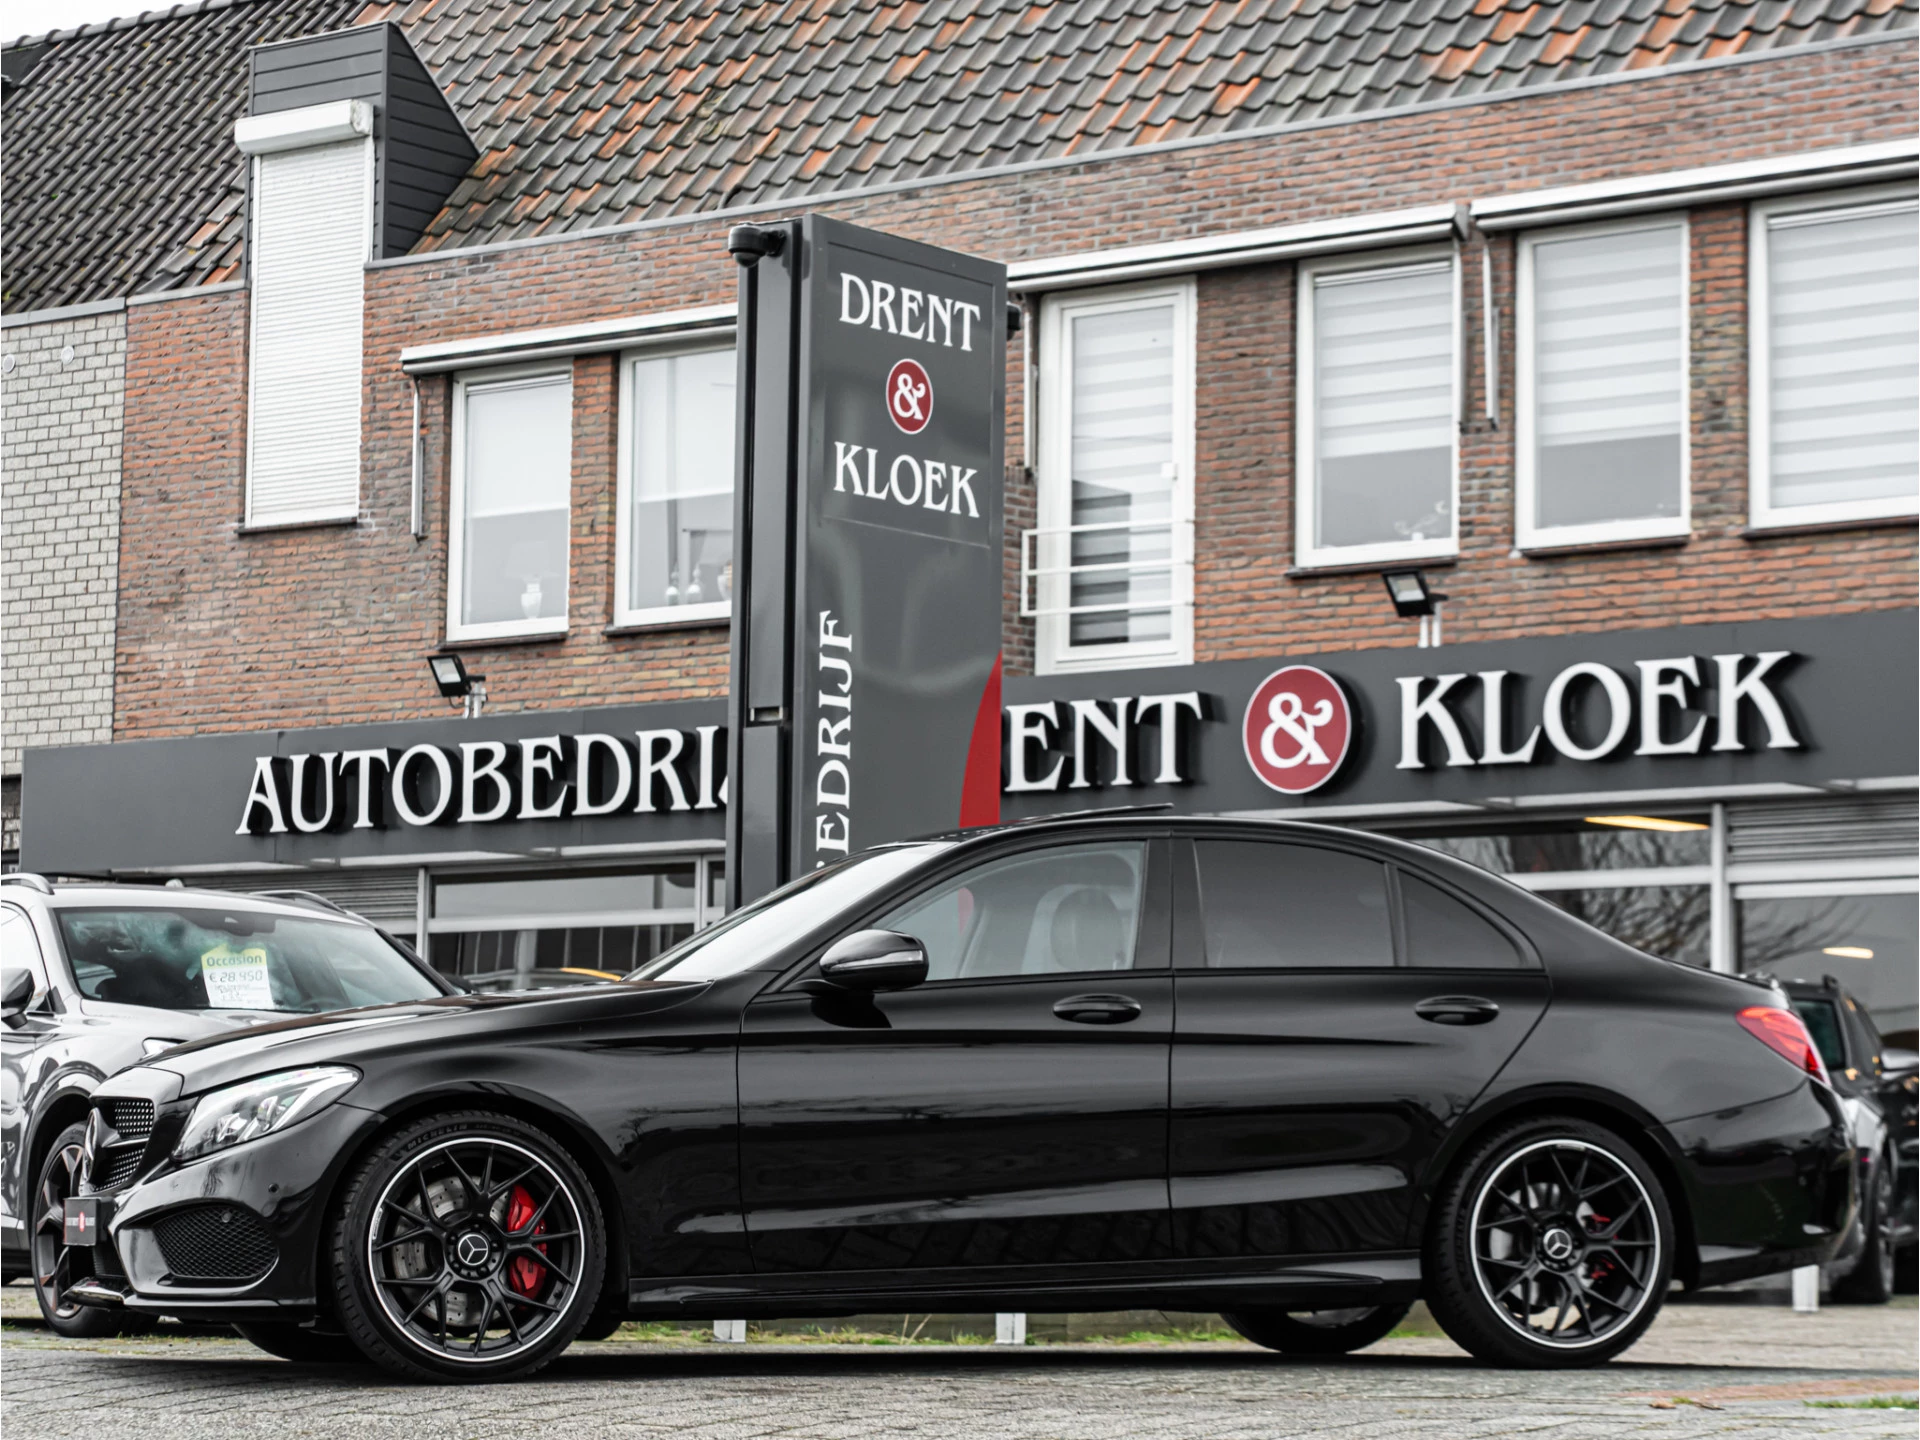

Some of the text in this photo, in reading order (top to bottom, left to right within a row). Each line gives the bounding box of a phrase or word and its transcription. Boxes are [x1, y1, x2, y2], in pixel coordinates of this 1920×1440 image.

[839, 272, 981, 352] DRENT
[893, 373, 926, 420] &
[833, 441, 980, 518] KLOEK
[235, 725, 728, 835] AUTOBEDRI
[1260, 691, 1334, 769] &
[1395, 650, 1800, 769] KLOEK
[816, 609, 853, 868] EDRIJF
[206, 954, 262, 967] Occasion
[407, 1123, 468, 1150] MICHELIN
